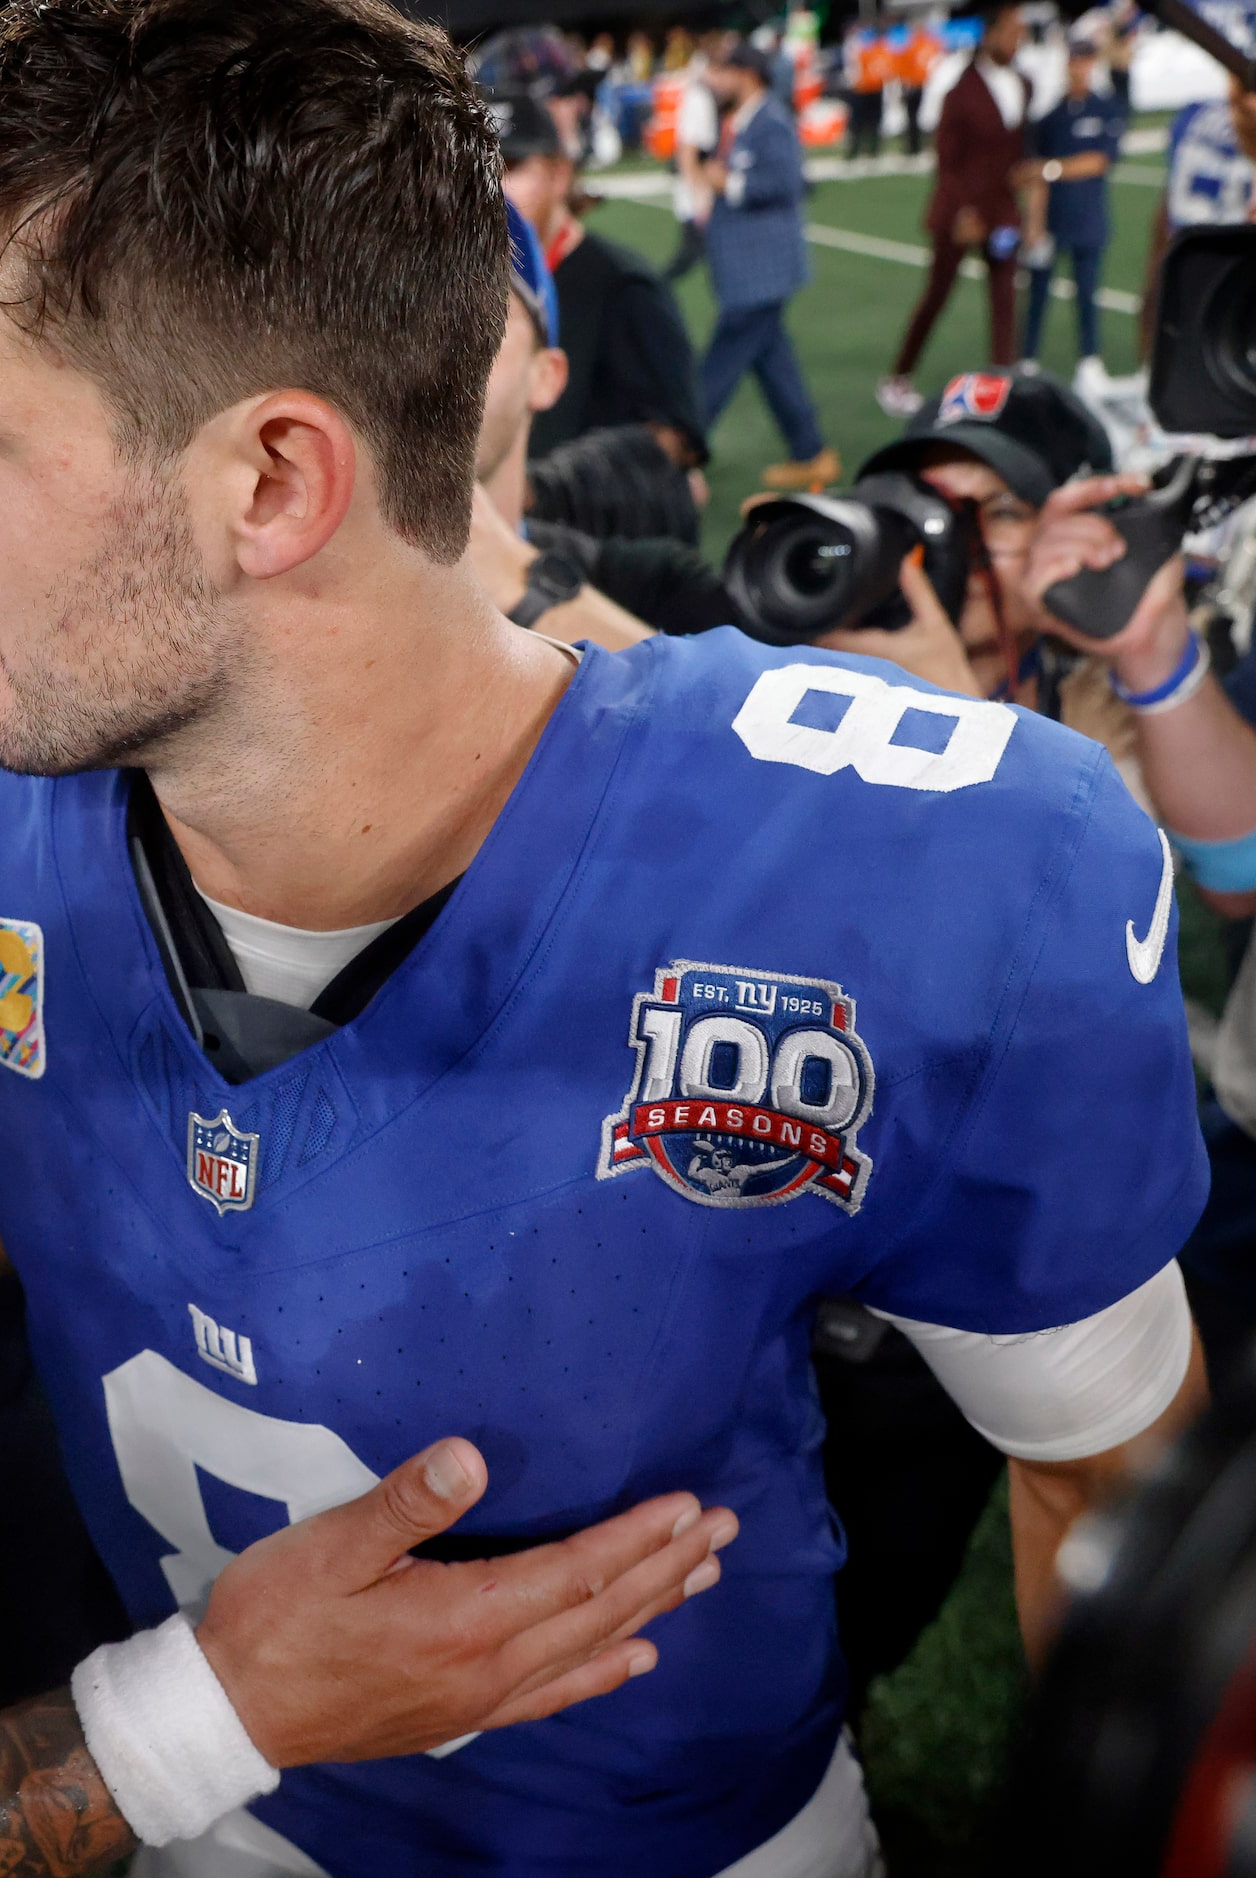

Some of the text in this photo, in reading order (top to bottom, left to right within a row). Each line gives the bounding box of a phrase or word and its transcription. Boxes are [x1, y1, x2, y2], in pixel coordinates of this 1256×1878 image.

[731, 663, 1019, 793] 8
[693, 983, 729, 1002] EST.
[781, 996, 823, 1016] 1925
[644, 1008, 861, 1130] 100
[648, 1106, 827, 1154] SEASONS
[198, 1152, 243, 1198] NFL
